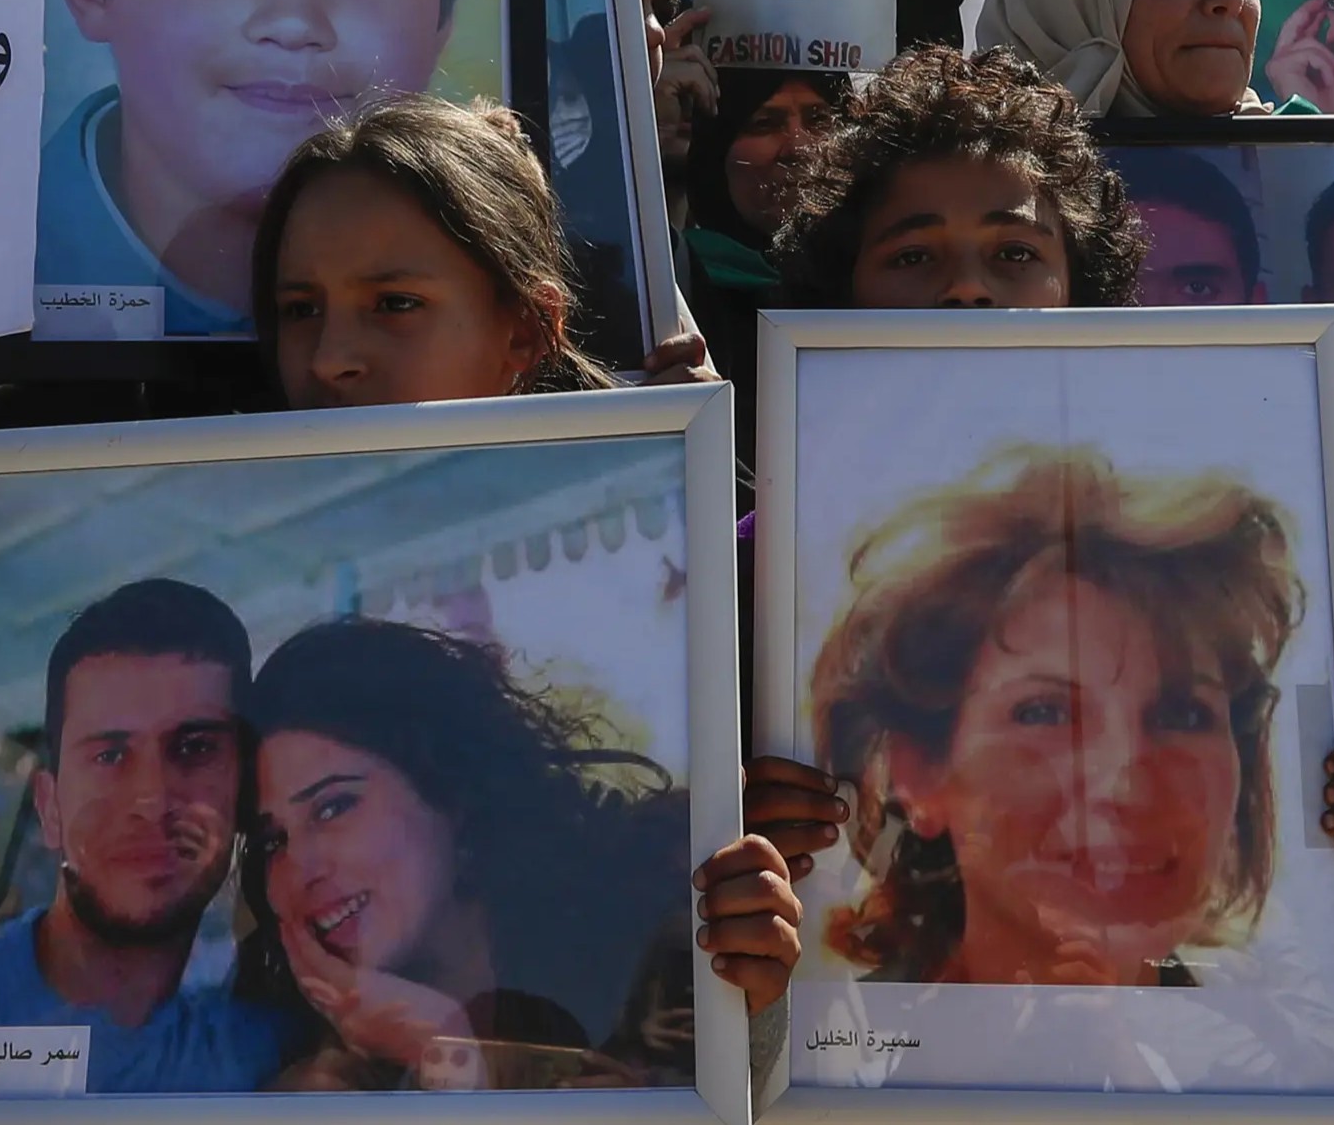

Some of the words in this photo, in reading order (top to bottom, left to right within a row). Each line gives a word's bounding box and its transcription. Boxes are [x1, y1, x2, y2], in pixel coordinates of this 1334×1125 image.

[705, 30, 801, 67] FASHION
[39, 291, 101, 310] الخطيب
[109, 292, 151, 312] حمزة
[805, 1029, 858, 1051] الخليل
[866, 1030, 921, 1052] سميرة
[40, 1047, 81, 1066] سمر
